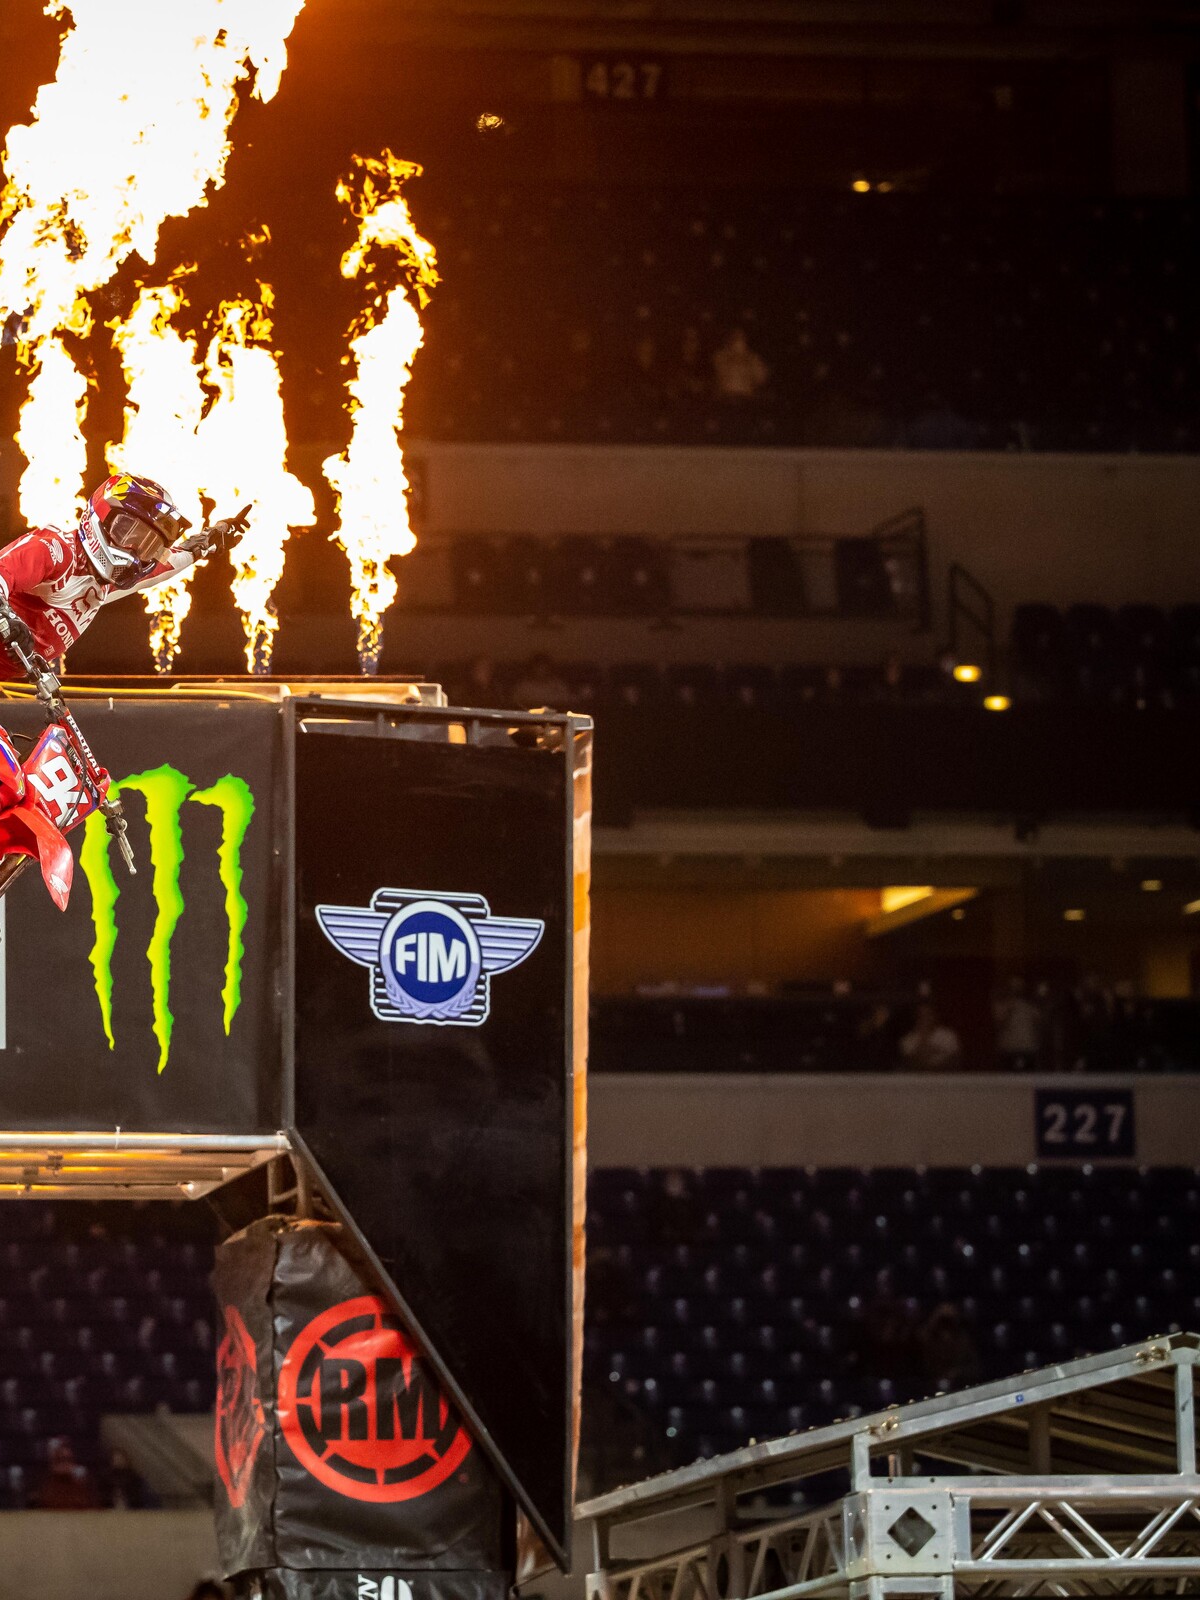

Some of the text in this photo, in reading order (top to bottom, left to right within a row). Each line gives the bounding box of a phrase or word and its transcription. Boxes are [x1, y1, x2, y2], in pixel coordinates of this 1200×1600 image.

[587, 62, 662, 98] 427
[66, 714, 101, 776] RENTHAL
[27, 755, 89, 829] 94
[395, 932, 467, 983] FIM
[1043, 1103, 1126, 1143] 227
[319, 1356, 442, 1441] RM
